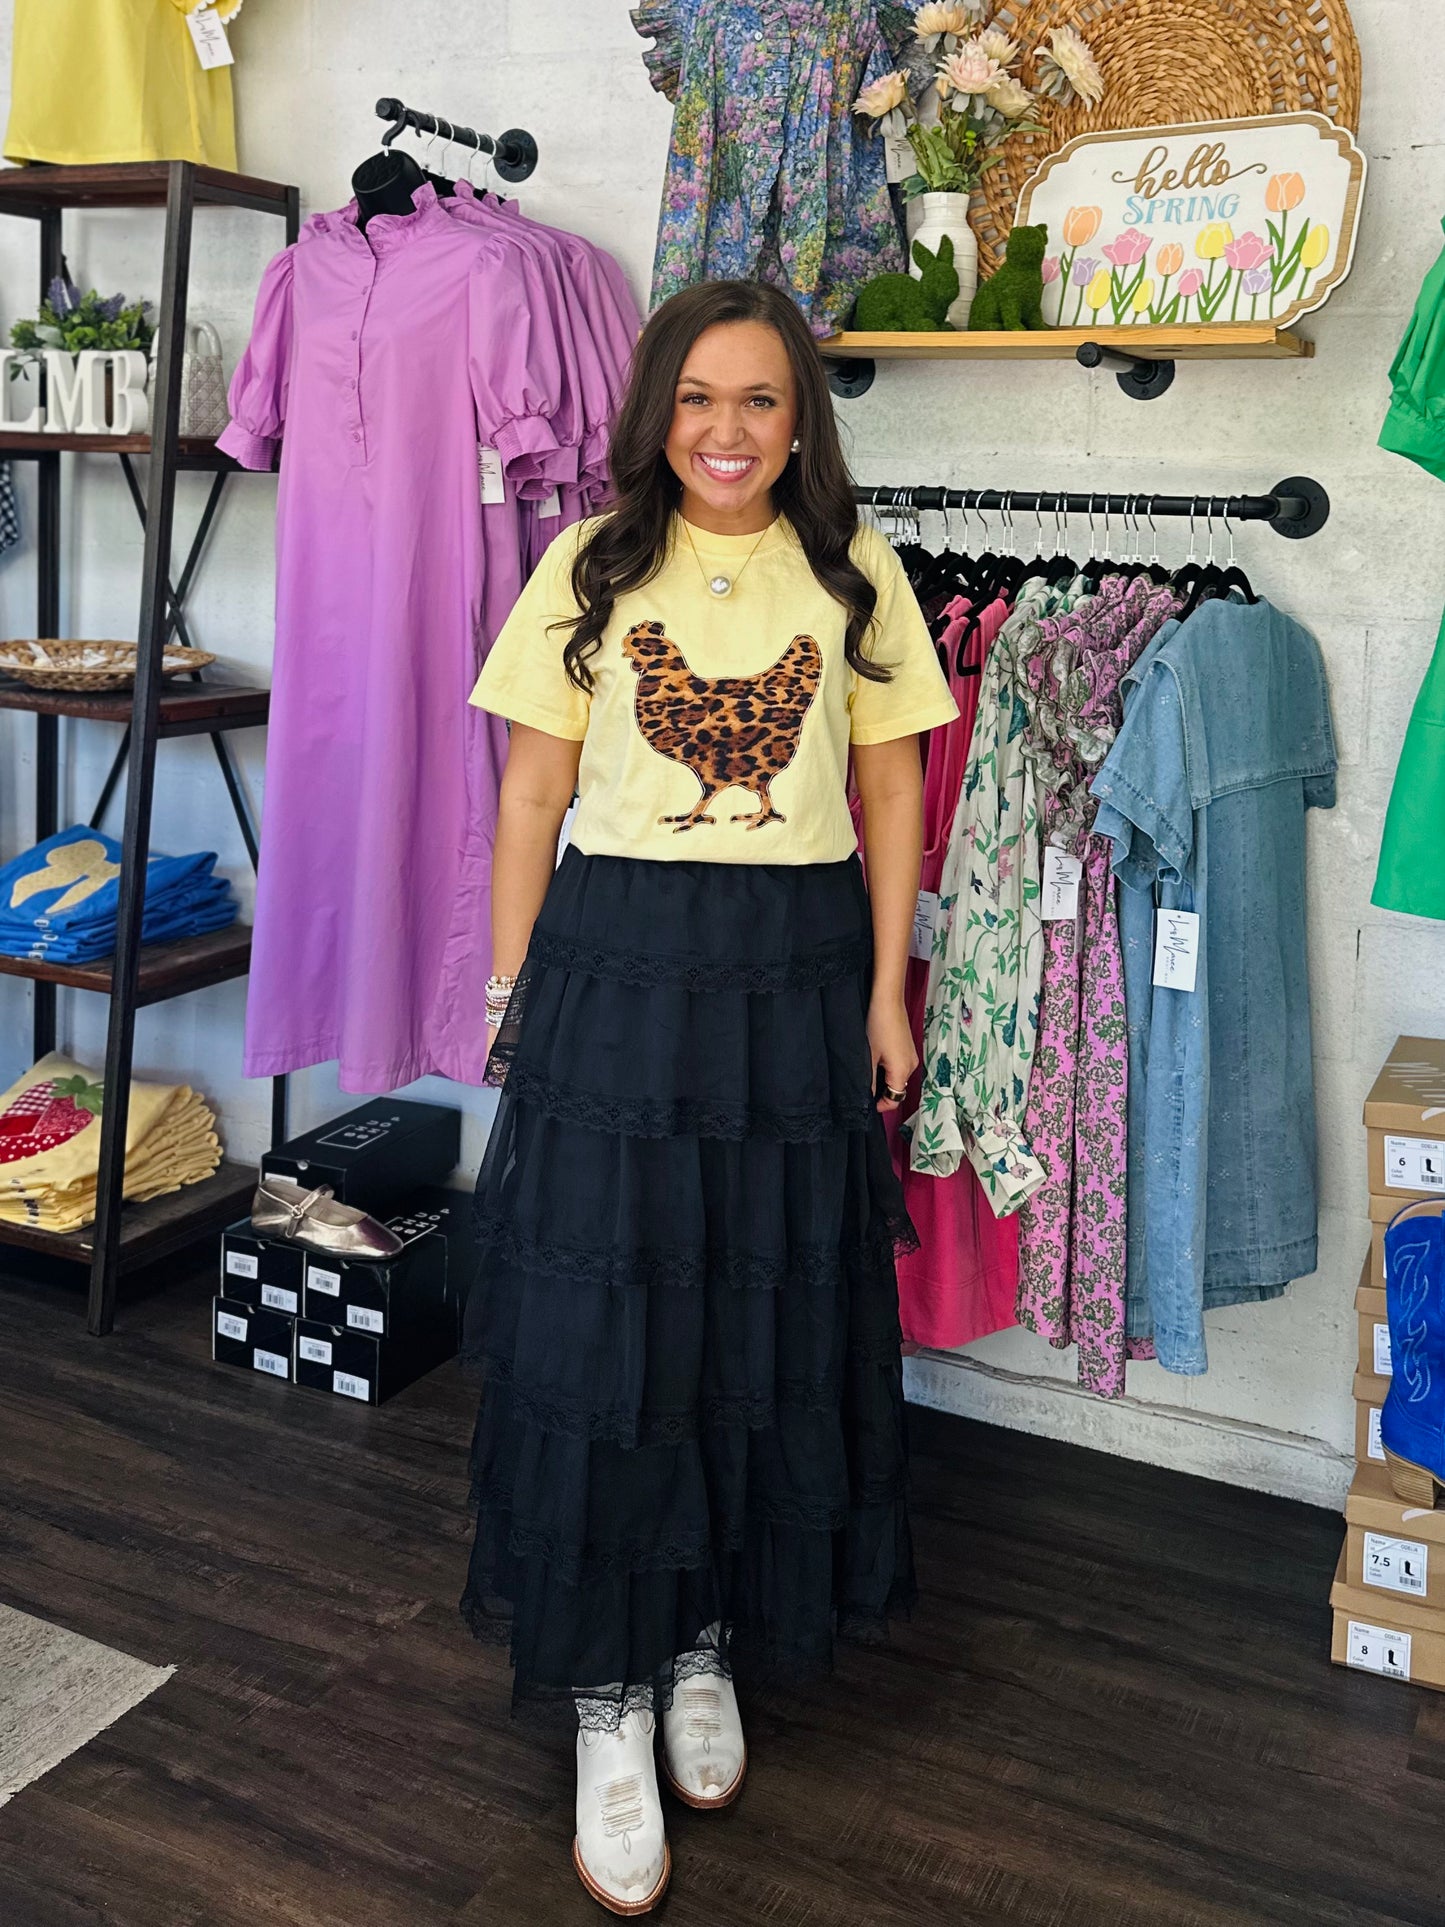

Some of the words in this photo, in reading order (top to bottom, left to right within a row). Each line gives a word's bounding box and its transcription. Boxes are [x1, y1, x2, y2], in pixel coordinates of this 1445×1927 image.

[1111, 142, 1268, 200] hello
[1122, 192, 1241, 225] SPRING
[1399, 1157, 1406, 1166] 6
[1372, 1554, 1391, 1567] 7.5
[1361, 1645, 1368, 1655] 8
